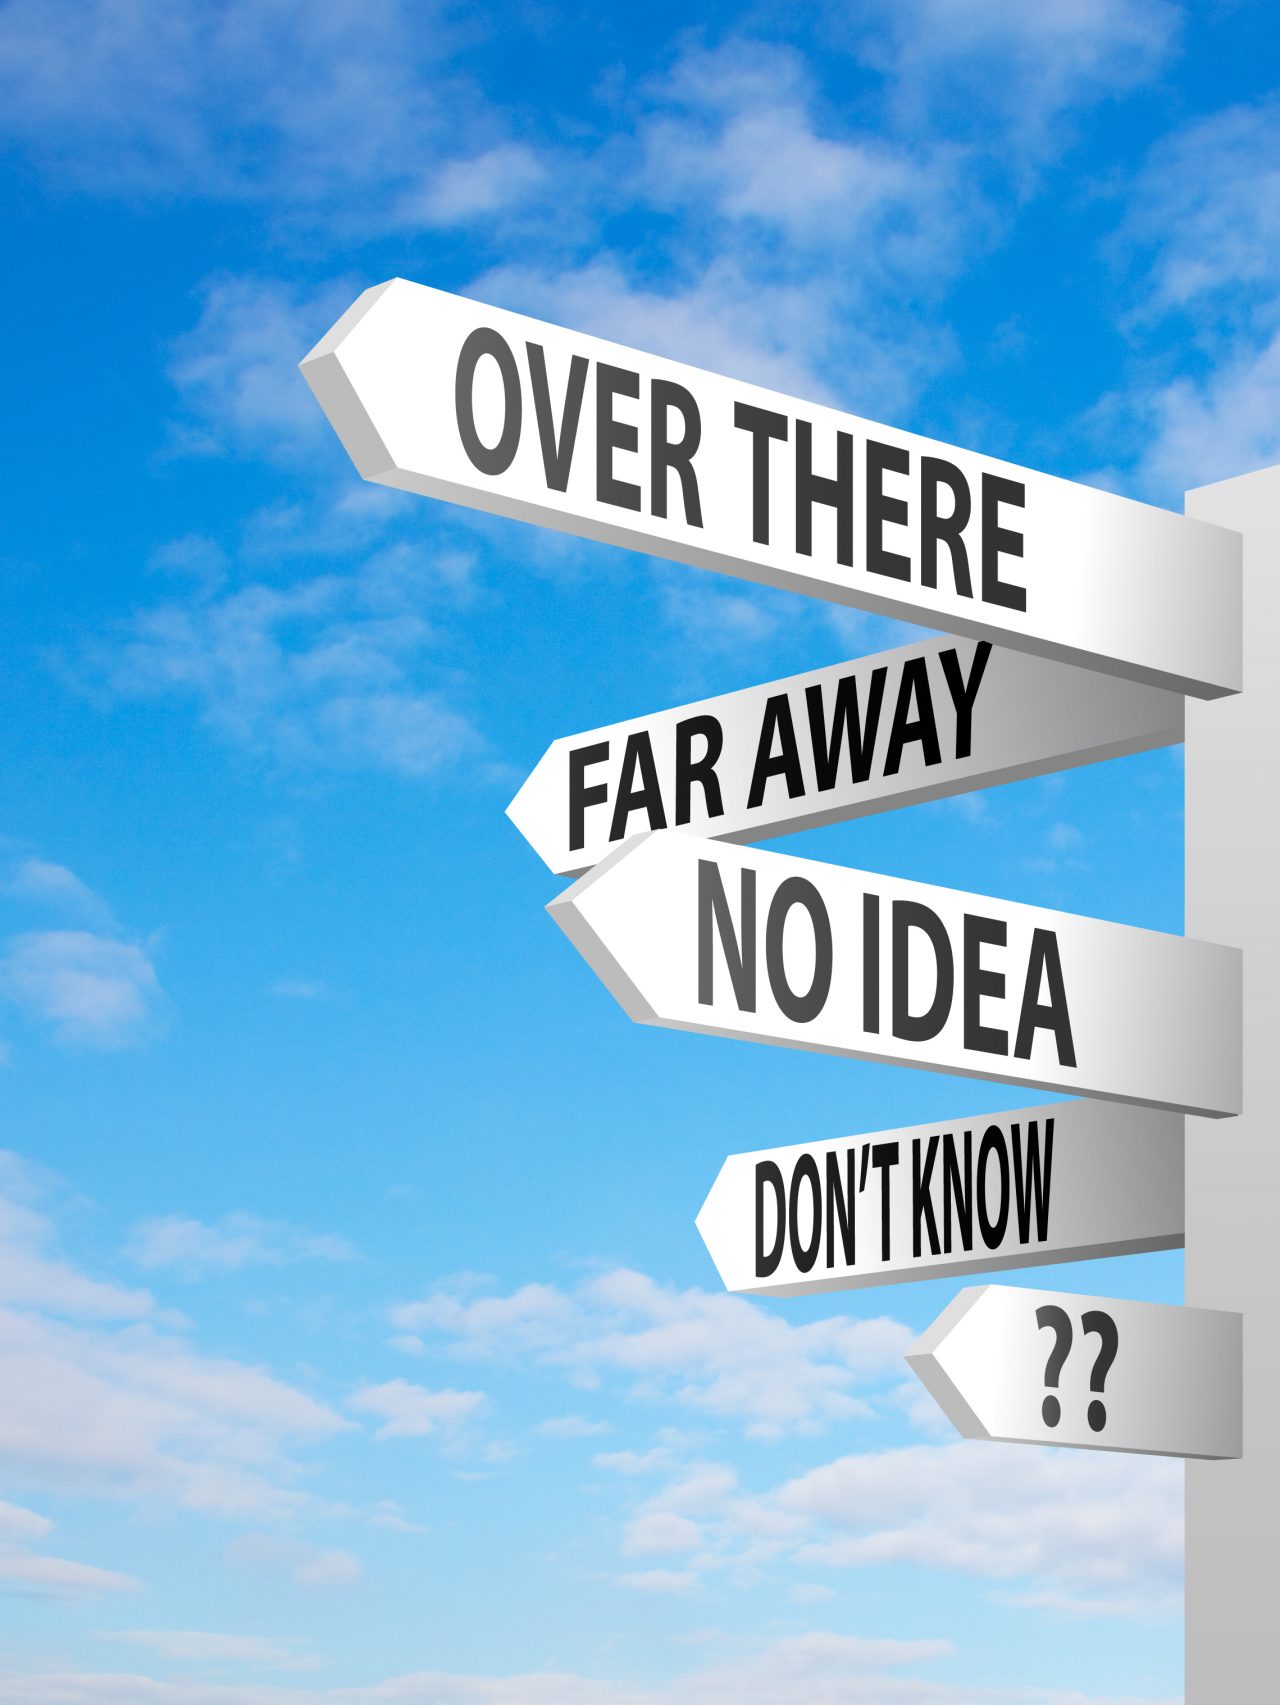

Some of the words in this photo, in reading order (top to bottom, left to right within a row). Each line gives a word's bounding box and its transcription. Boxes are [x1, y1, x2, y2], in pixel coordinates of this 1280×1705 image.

[456, 327, 704, 529] OVER
[734, 401, 1028, 613] THERE
[569, 714, 725, 852] FAR
[746, 641, 993, 810] AWAY
[697, 859, 833, 1024] NO
[863, 892, 1077, 1068] IDEA
[755, 1141, 900, 1278] DON'T
[912, 1117, 1055, 1258] KNOW
[1035, 1305, 1119, 1433] ??
